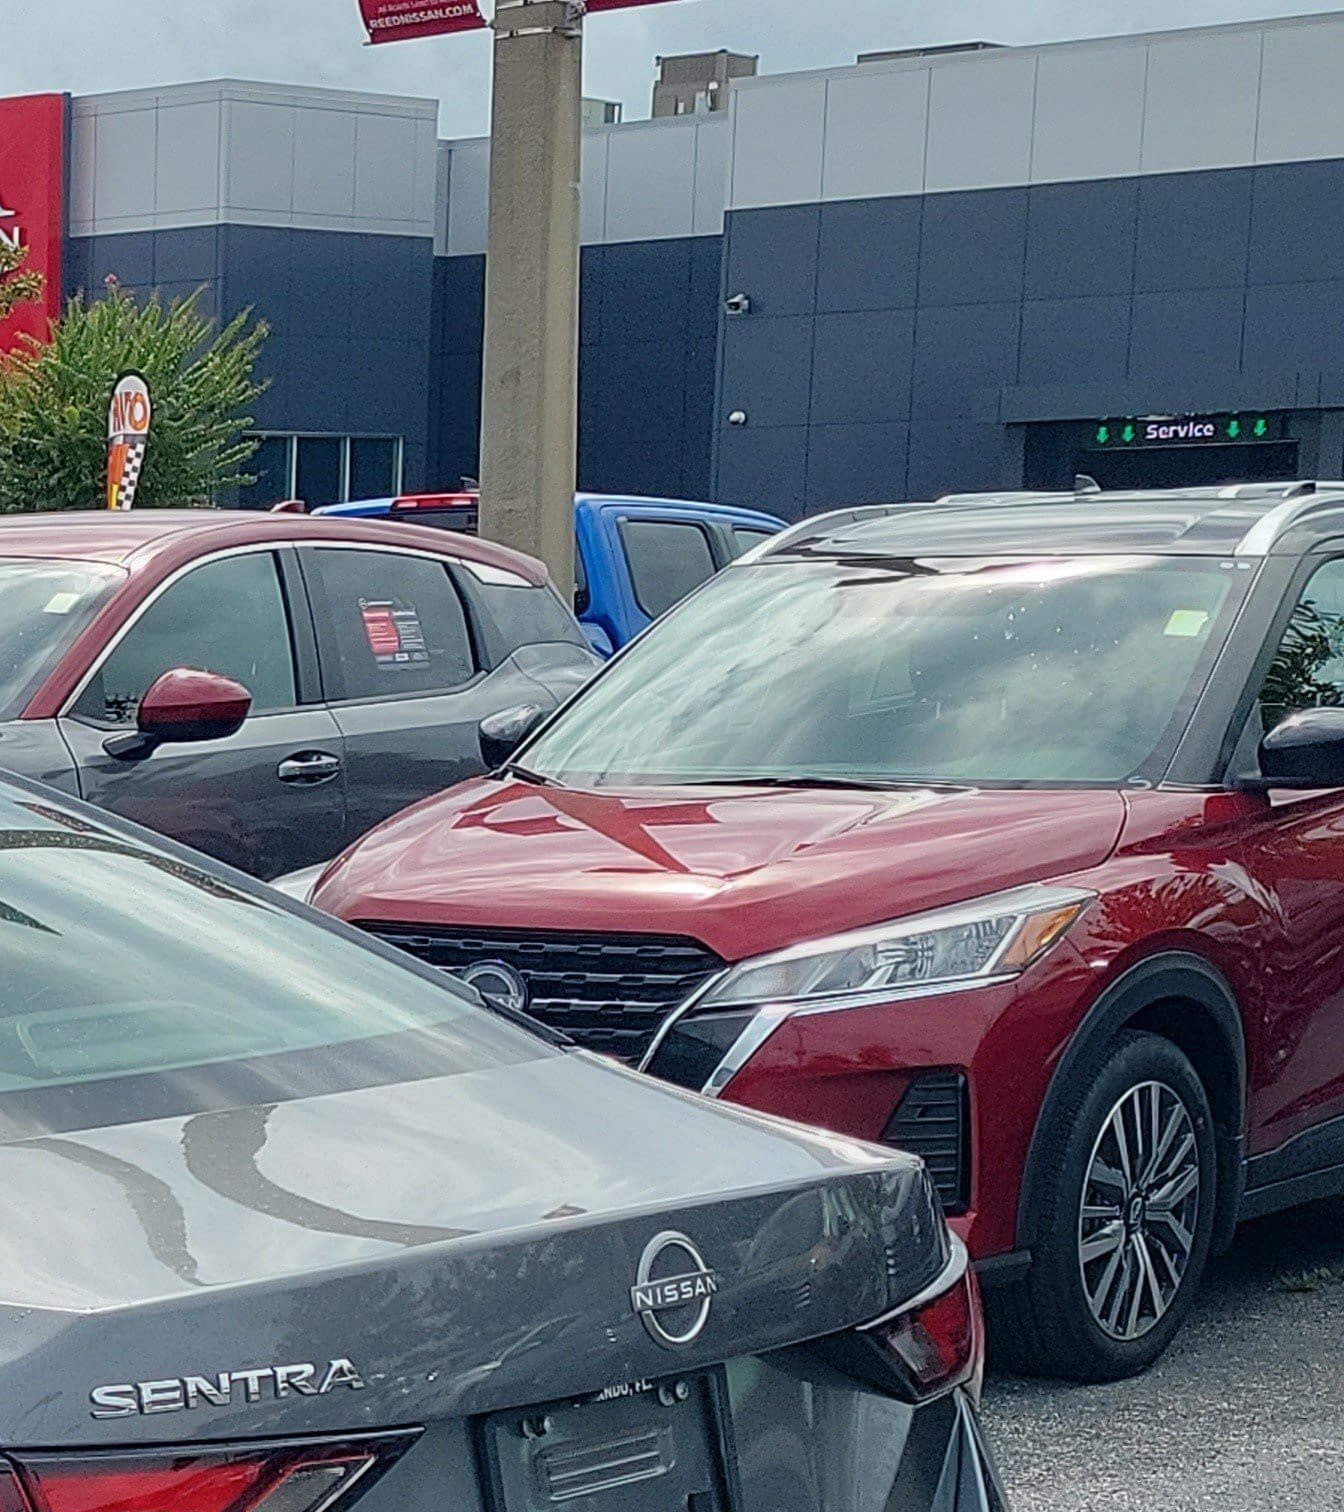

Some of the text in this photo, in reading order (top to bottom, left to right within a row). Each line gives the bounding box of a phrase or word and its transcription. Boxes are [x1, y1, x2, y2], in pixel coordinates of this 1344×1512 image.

[370, 4, 474, 28] REEDNISSAN.COM
[1145, 421, 1215, 440] Service
[636, 1276, 717, 1308] NISSAN
[90, 1357, 365, 1420] SENTRA
